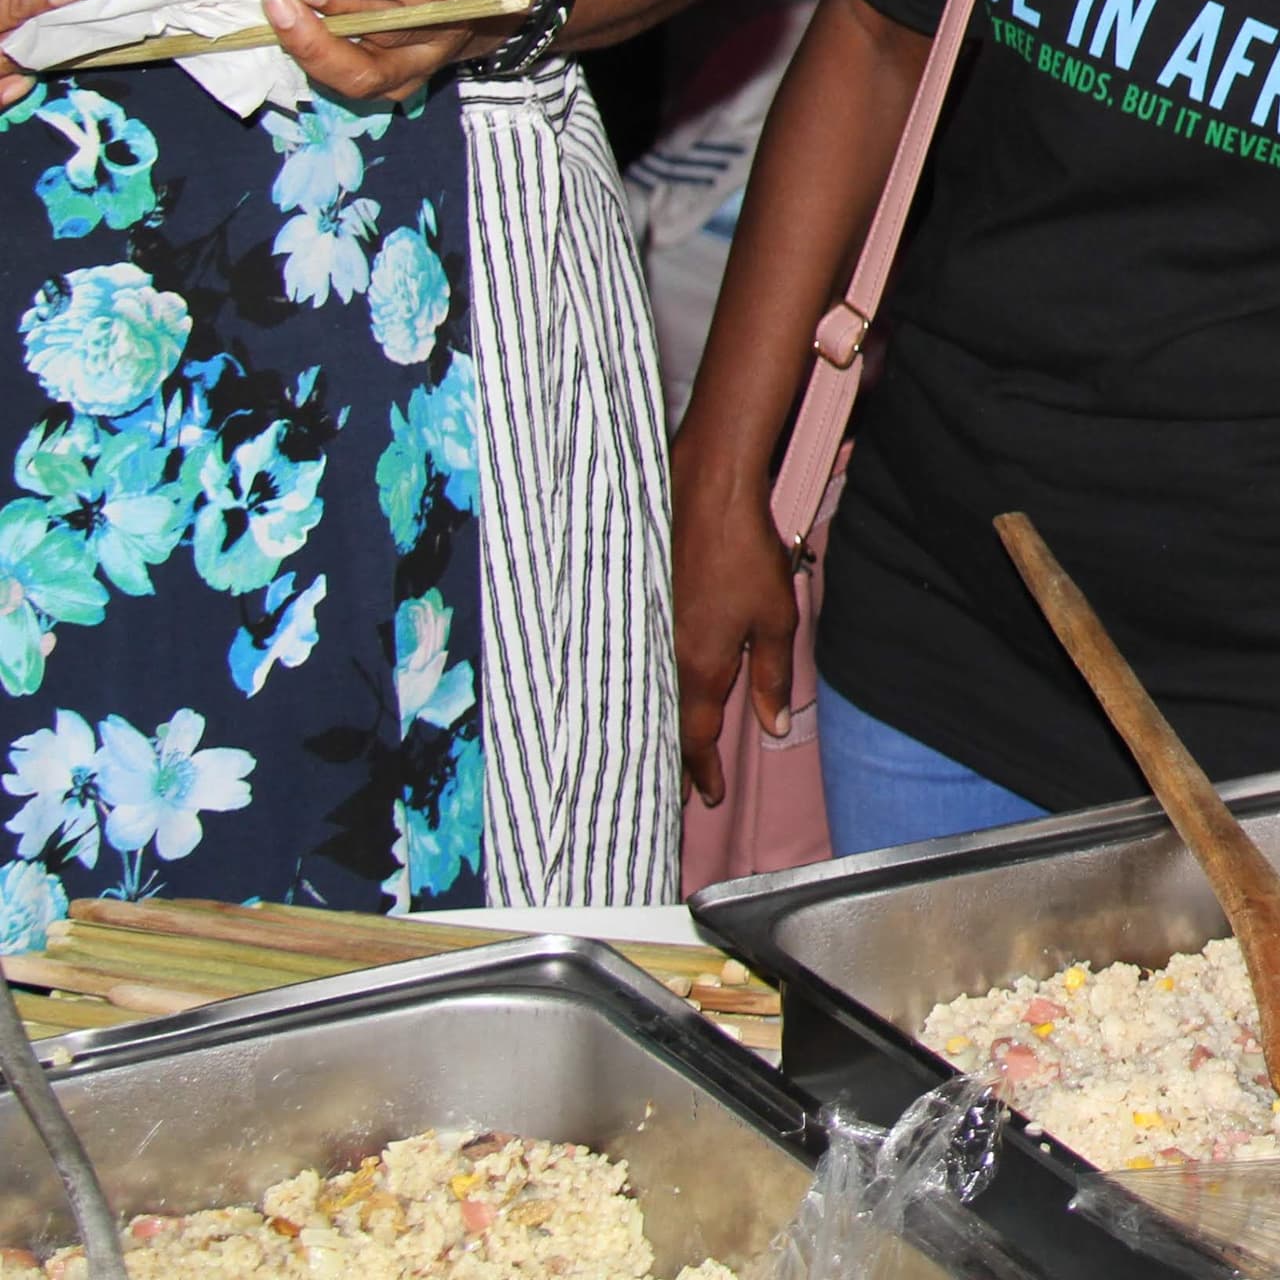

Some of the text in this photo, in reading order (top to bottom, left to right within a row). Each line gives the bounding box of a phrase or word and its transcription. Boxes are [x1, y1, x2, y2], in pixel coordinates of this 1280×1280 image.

[991, 16, 1036, 63] TREE
[1037, 43, 1114, 106] BENDS,
[1121, 83, 1174, 127] BUT
[1174, 106, 1202, 138] IT
